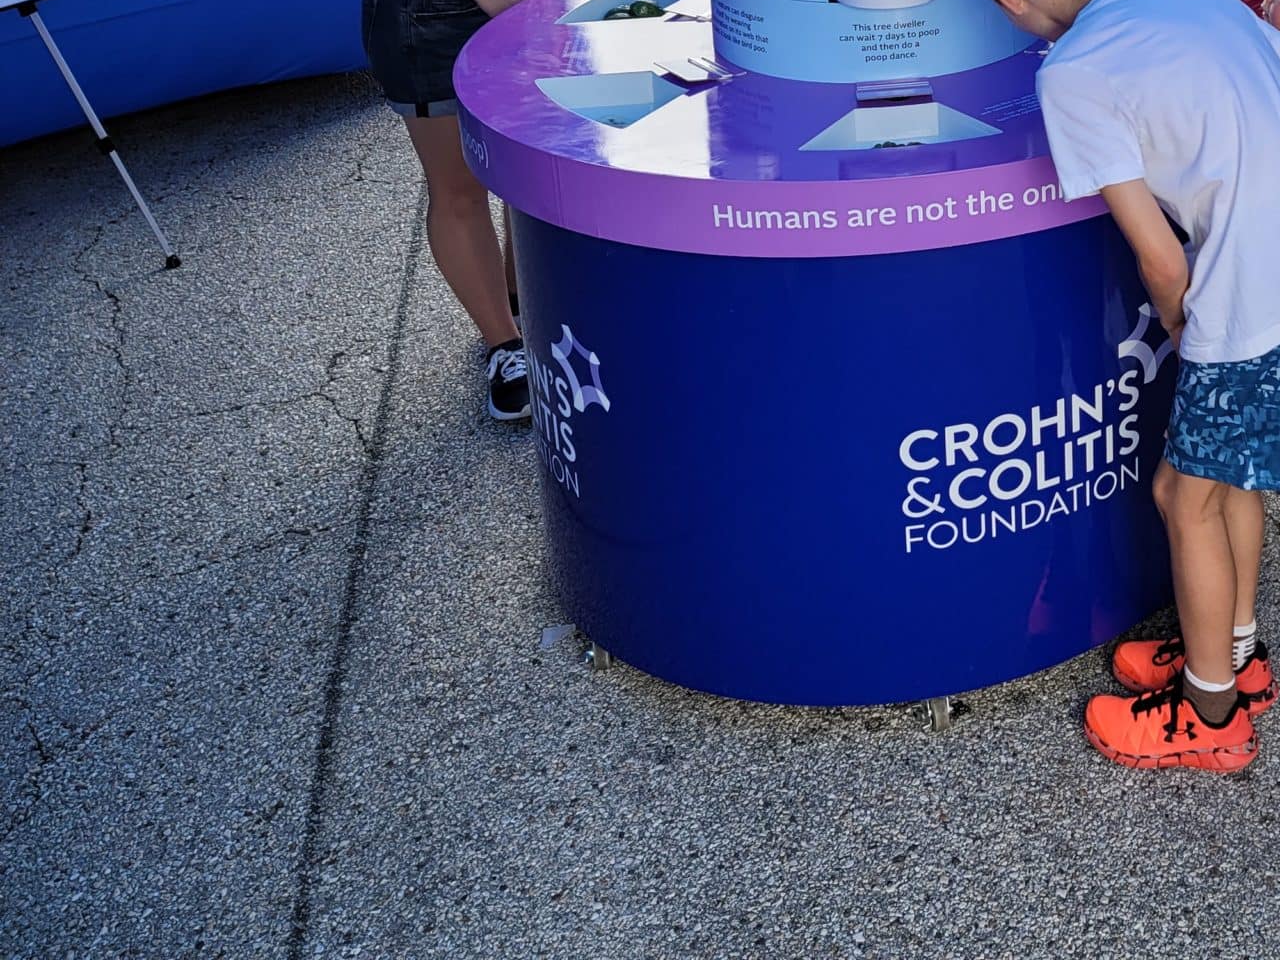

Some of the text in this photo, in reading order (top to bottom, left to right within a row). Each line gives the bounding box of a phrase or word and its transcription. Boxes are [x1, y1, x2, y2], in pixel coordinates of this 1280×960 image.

[852, 19, 926, 32] This tree dweller
[839, 28, 940, 42] can wait 7 days to poop
[861, 44, 877, 52] and
[879, 42, 900, 51] then
[901, 41, 913, 50] do
[865, 51, 918, 63] poop dance.
[712, 182, 1072, 230] Humans are not the onl
[899, 369, 1140, 471] CROHN'S
[905, 456, 1139, 553] FOUNDATION
